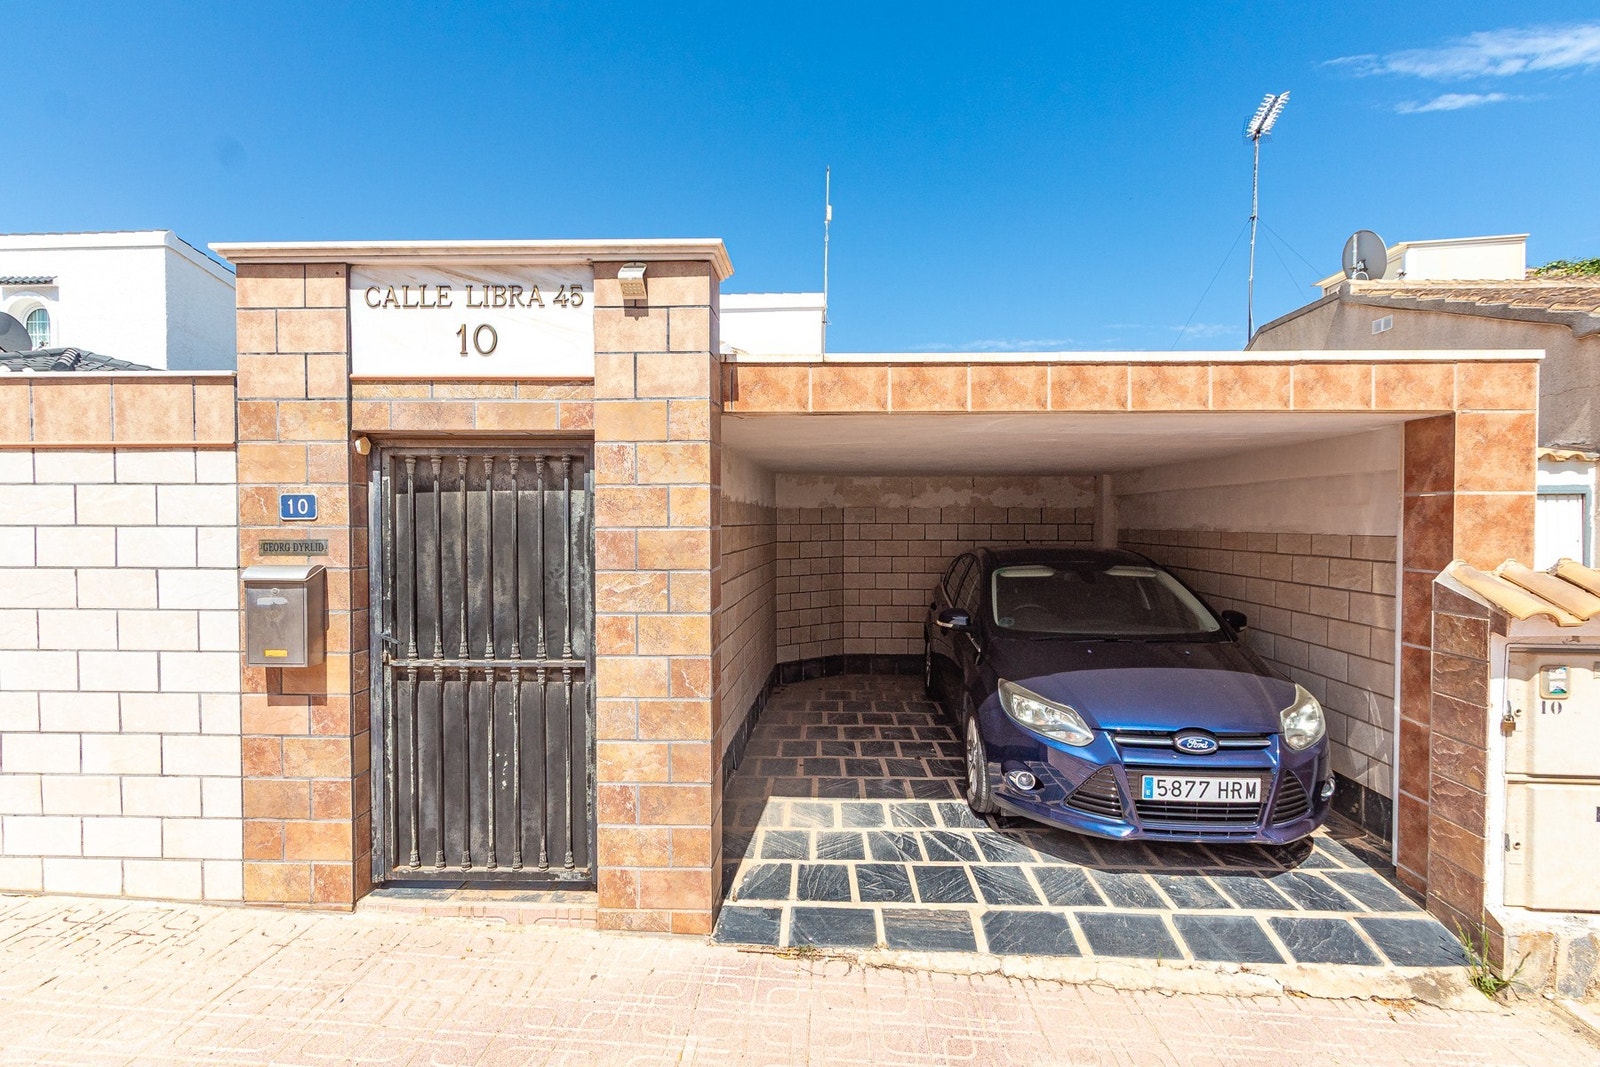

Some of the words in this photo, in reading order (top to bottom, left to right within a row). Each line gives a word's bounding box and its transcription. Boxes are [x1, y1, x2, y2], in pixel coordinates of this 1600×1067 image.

[364, 284, 453, 308] CALLE
[465, 284, 545, 308] LIBRA
[552, 284, 584, 308] 45
[456, 323, 498, 356] 10
[287, 498, 309, 515] 10
[263, 542, 290, 552] GEORG
[1541, 700, 1562, 715] 10
[1187, 739, 1208, 748] Ford
[1157, 780, 1210, 798] 5877
[1218, 781, 1256, 799] HRM
